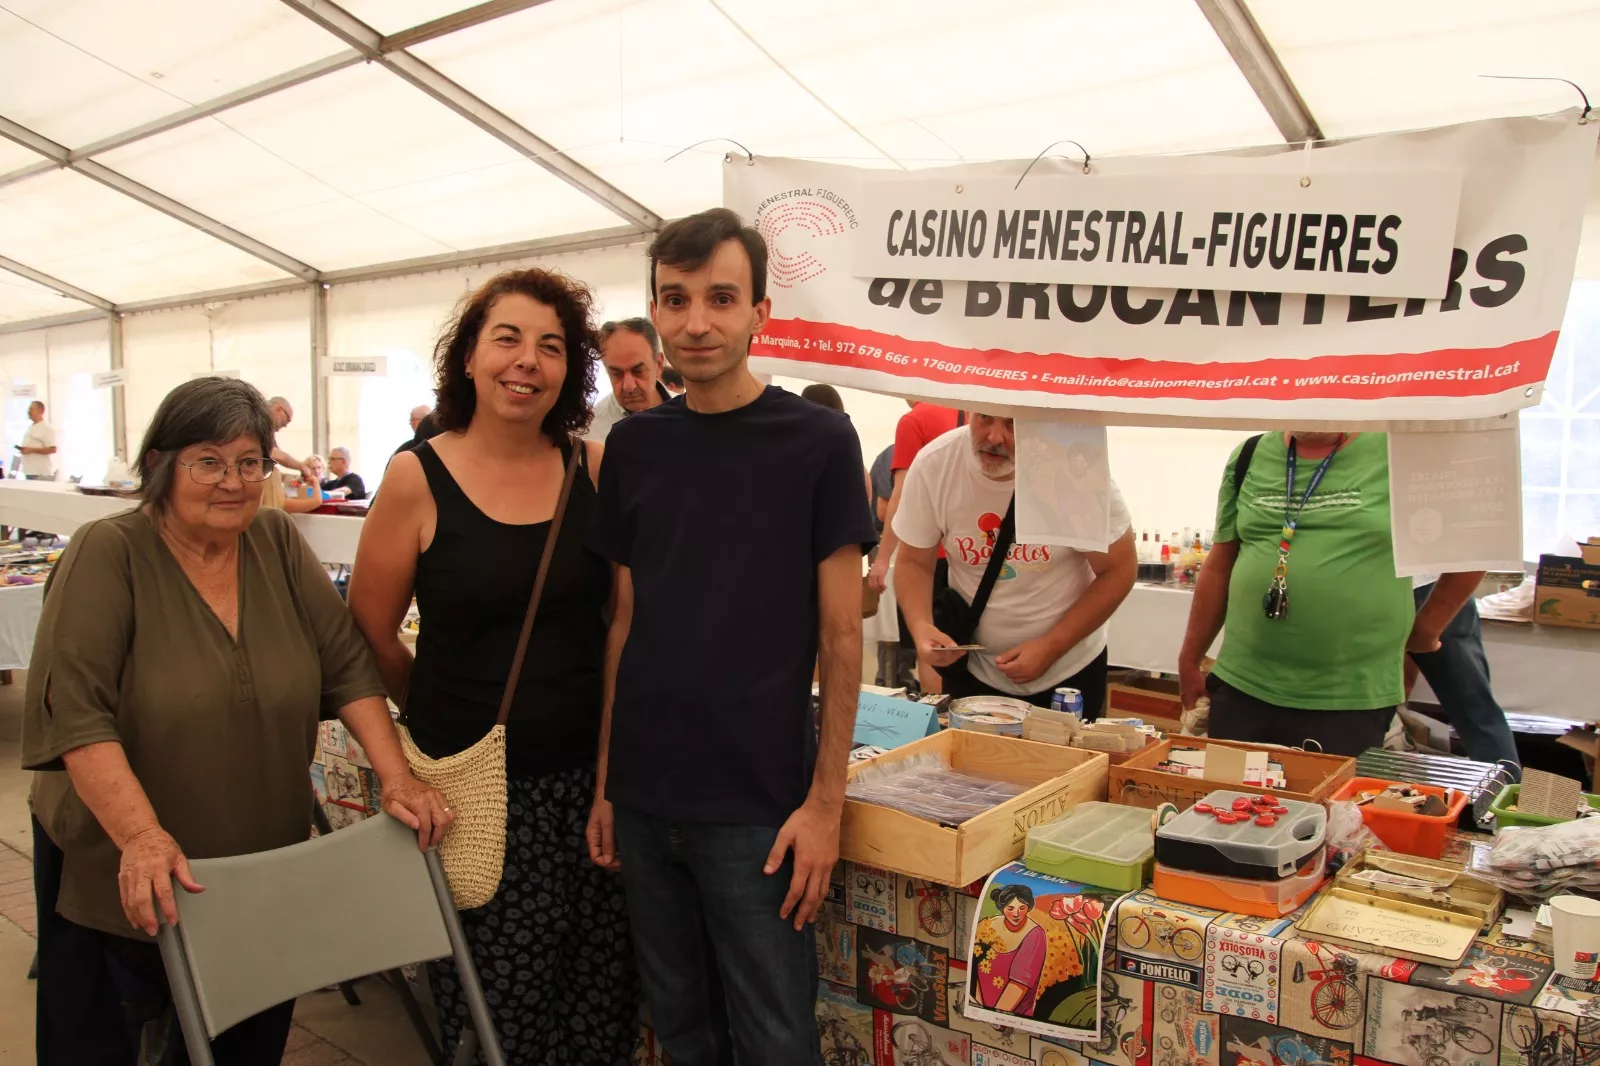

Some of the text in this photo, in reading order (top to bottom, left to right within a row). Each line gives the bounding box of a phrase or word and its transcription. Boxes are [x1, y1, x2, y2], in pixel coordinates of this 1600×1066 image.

[757, 188, 859, 230] MENESTRAL FIGUERENC
[886, 209, 1402, 275] CASINO MENESTRAL-FIGUERES
[761, 335, 801, 349] Marquina,
[803, 338, 810, 349] 2
[819, 340, 833, 352] Tel.
[836, 341, 856, 354] 972
[858, 345, 882, 359] 678
[885, 351, 909, 366] 666
[922, 357, 962, 374] 17600
[963, 365, 1028, 381] FIGUERES
[1295, 360, 1520, 387] www.casinomenestral.cat
[955, 537, 1050, 565] Baelos
[1218, 941, 1266, 960] VELOSOLEX
[1139, 962, 1191, 982] PONTELLO
[1216, 986, 1264, 1003] CODE
